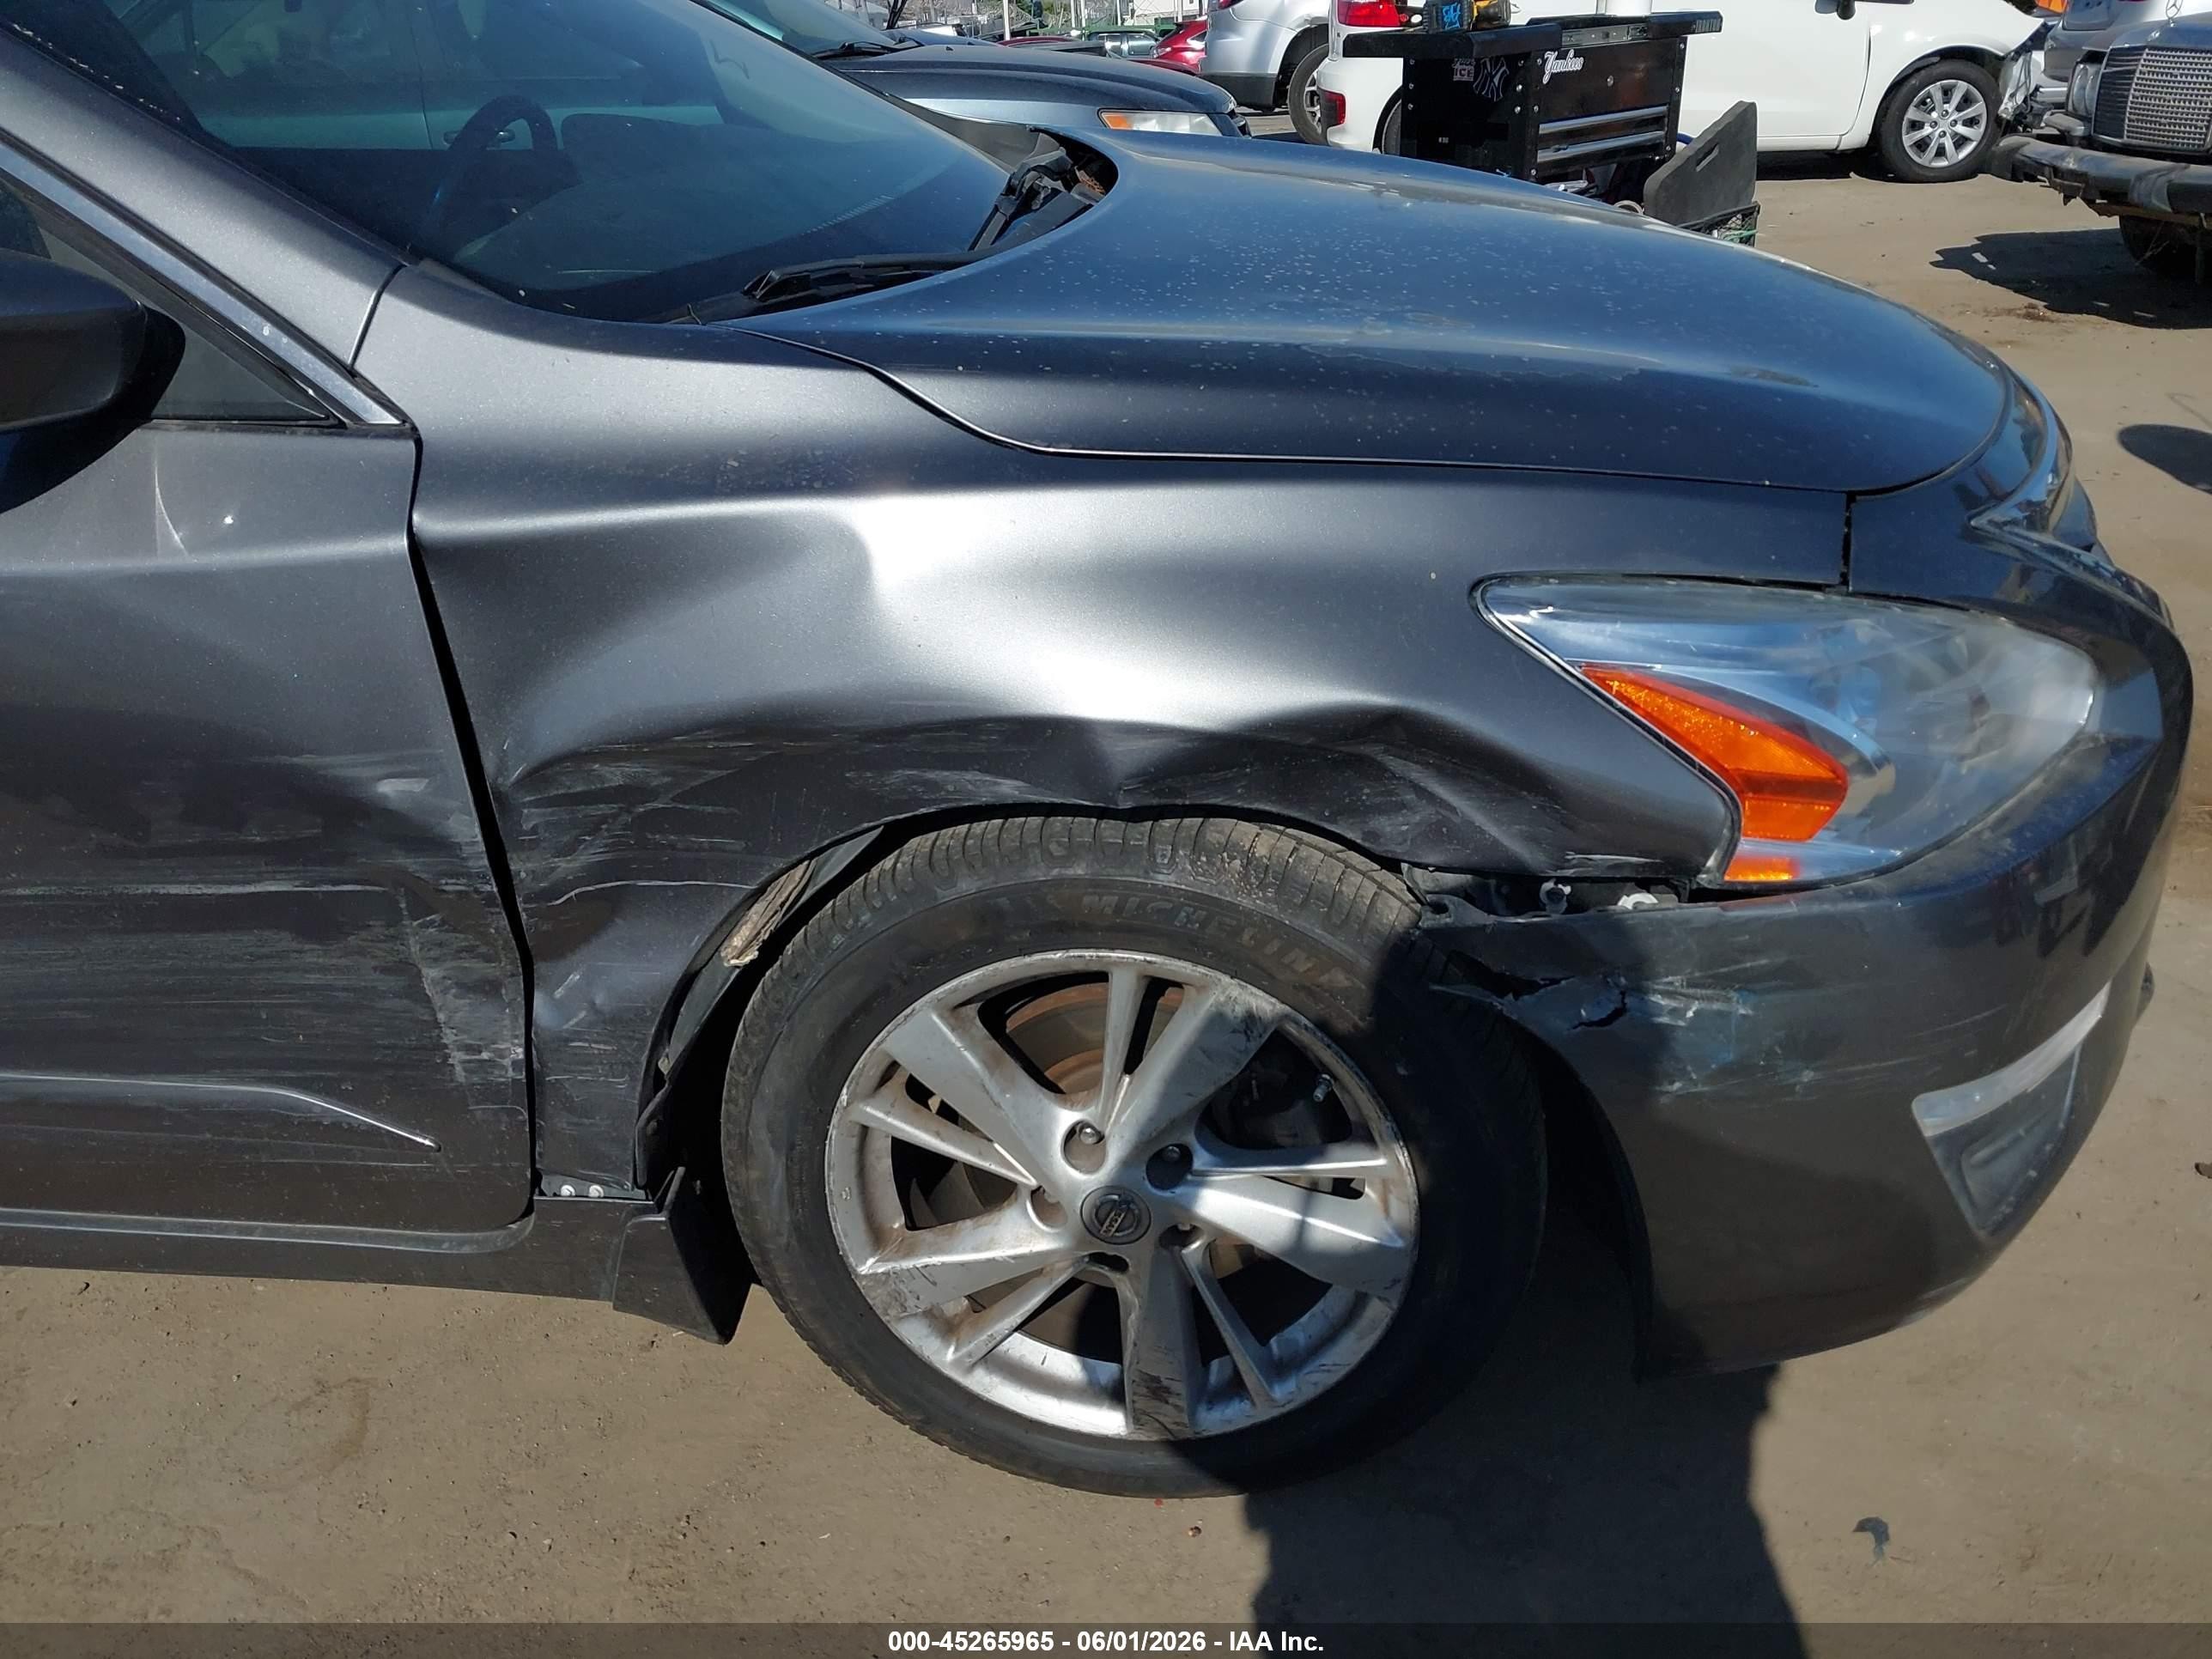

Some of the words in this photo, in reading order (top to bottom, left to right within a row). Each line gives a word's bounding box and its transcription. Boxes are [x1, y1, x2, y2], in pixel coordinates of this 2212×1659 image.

[1455, 68, 1473, 78] ICE
[1542, 49, 1585, 84] Yankees
[1082, 895, 1318, 973] MICHELIN
